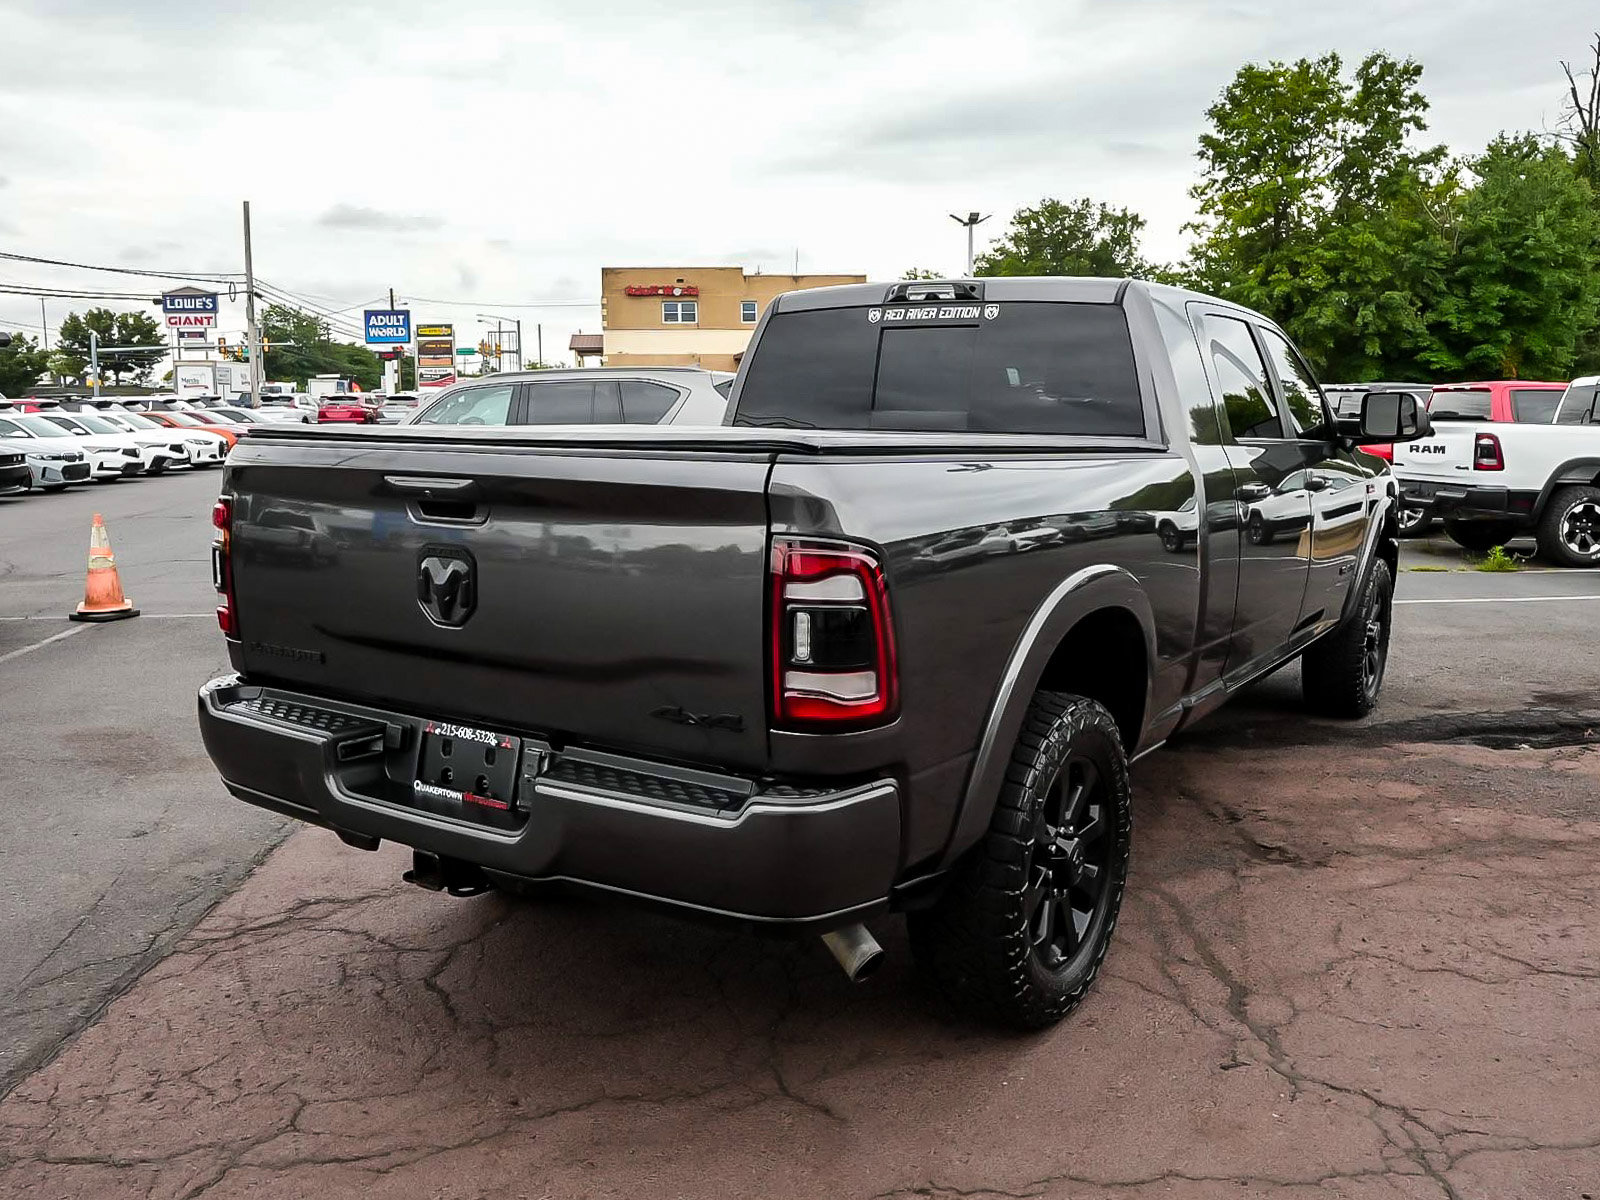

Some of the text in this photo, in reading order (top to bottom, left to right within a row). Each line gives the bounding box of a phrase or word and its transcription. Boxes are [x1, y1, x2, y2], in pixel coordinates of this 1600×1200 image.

[166, 297, 213, 309] LOWE'S
[884, 307, 981, 321] RED RIVER EDITION
[168, 316, 213, 326] GIANT
[369, 315, 405, 326] ADULT
[368, 327, 406, 337] WORLD
[1409, 444, 1446, 454] RAM
